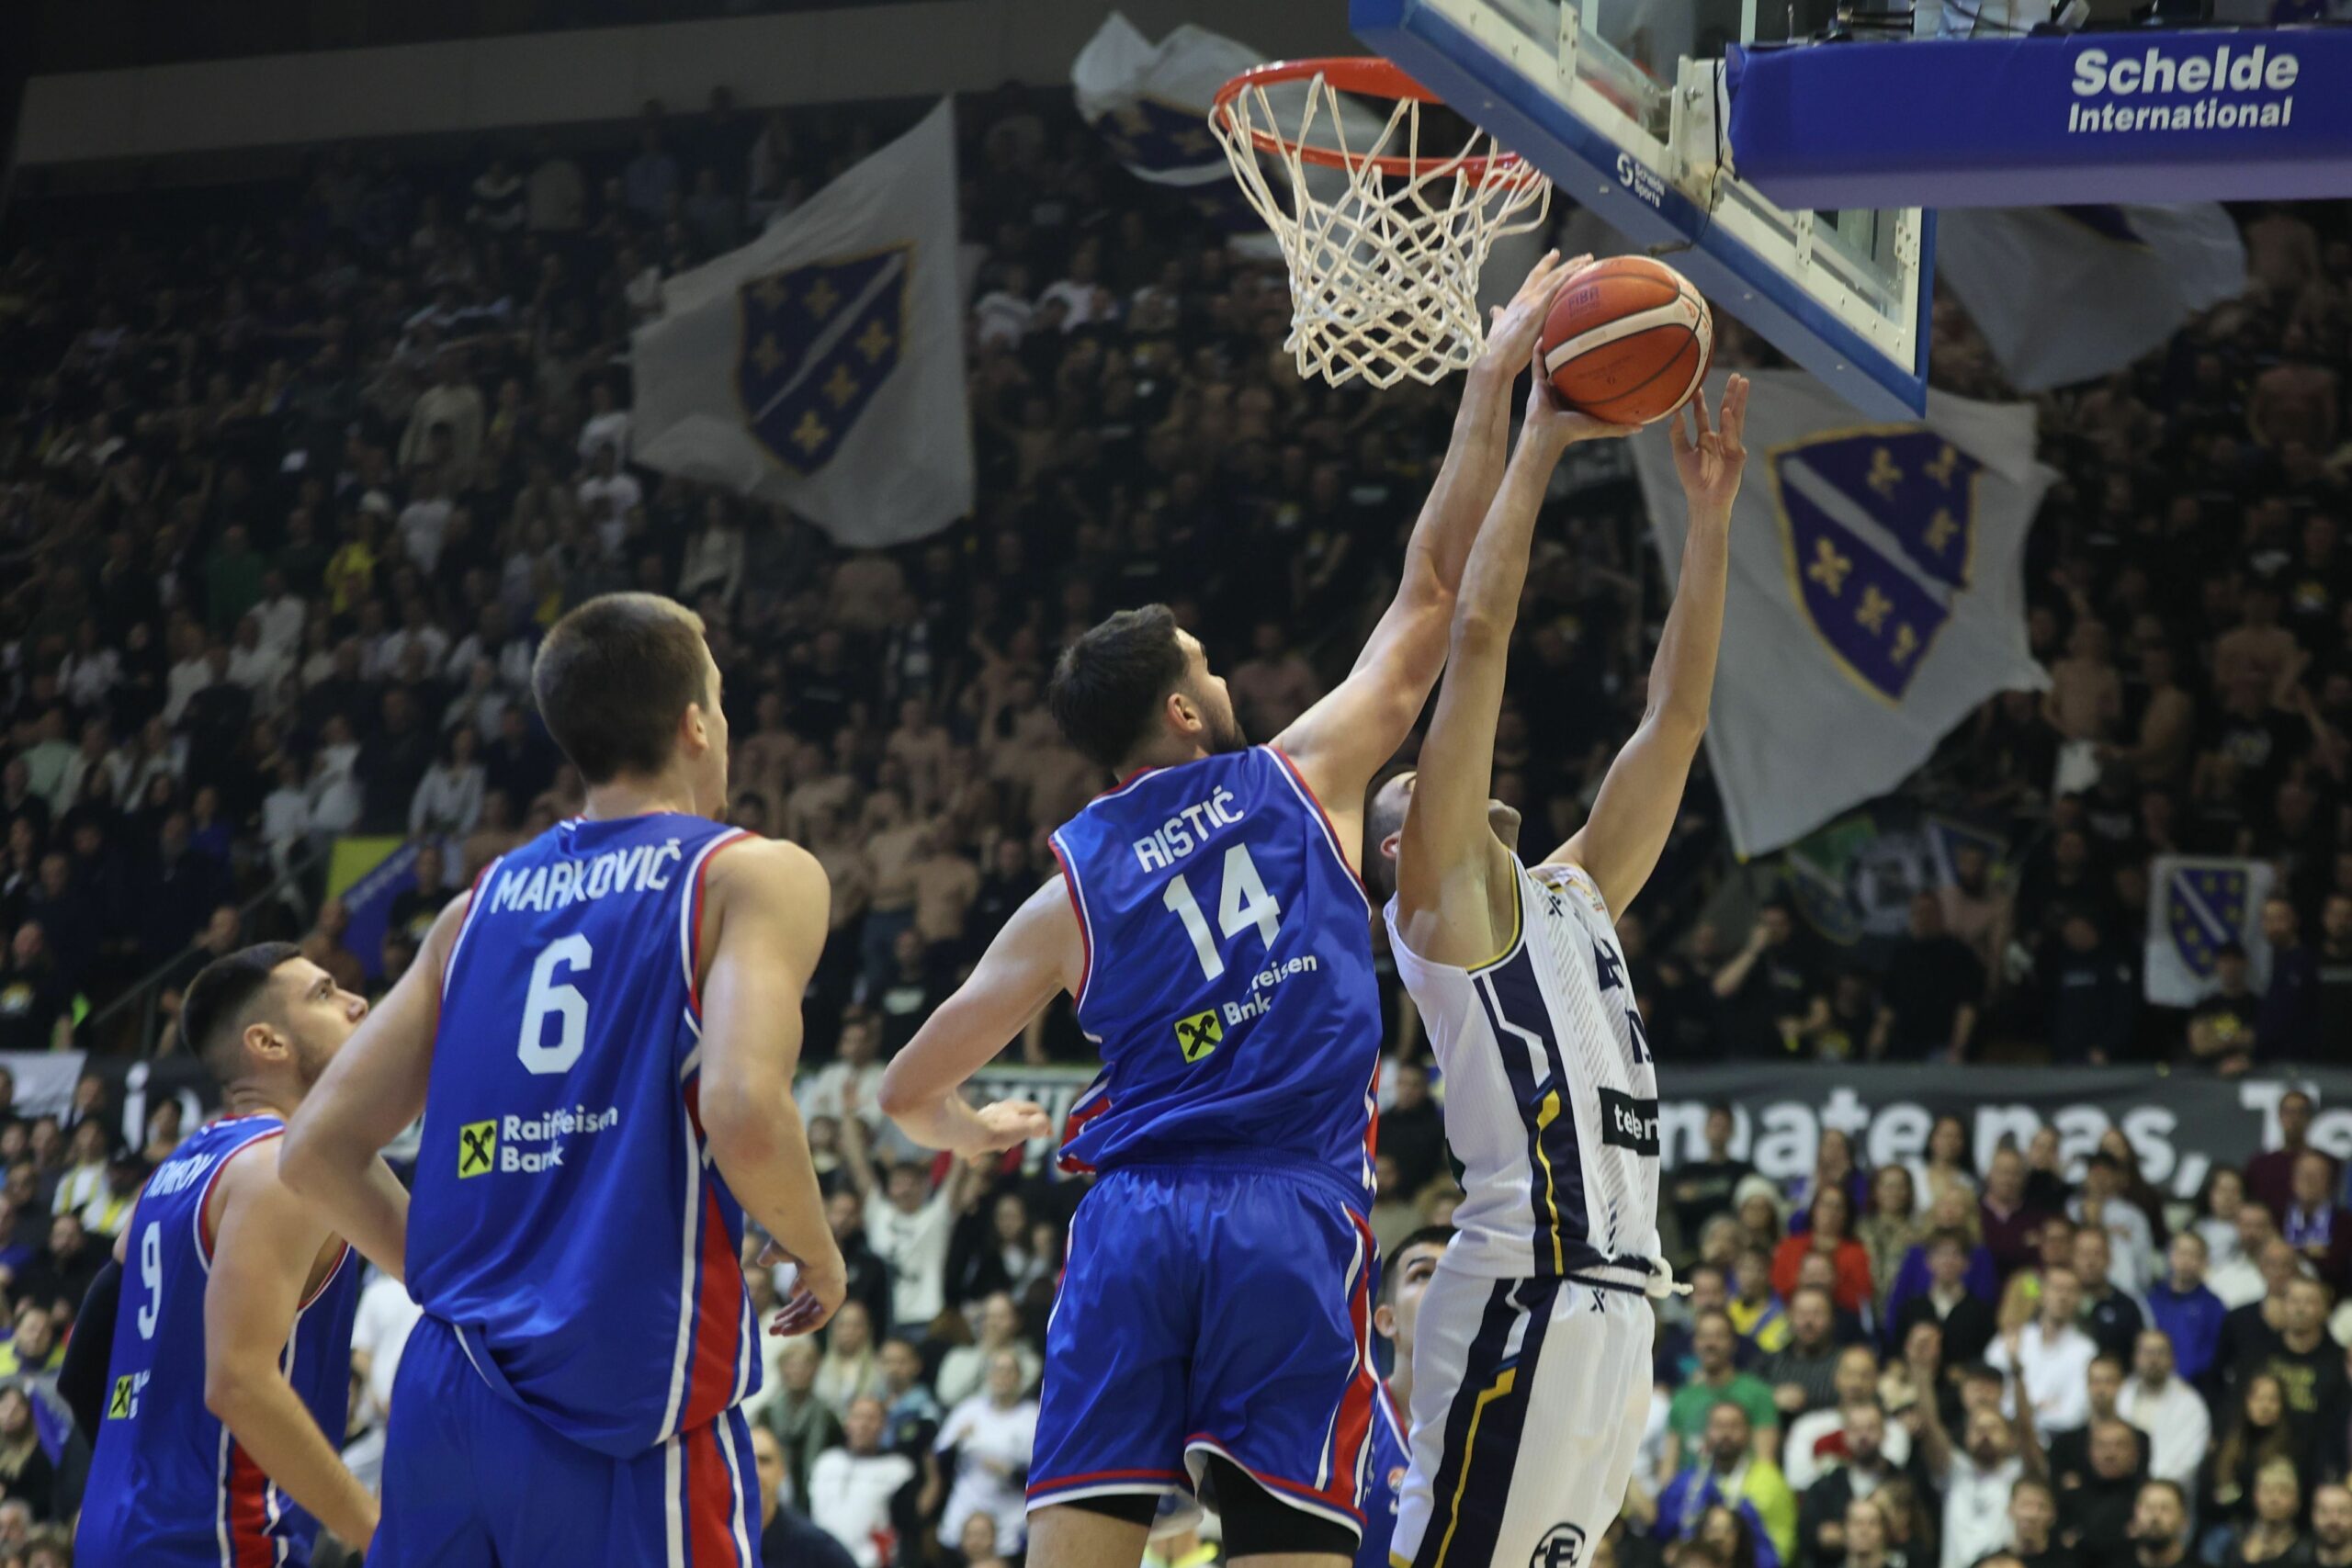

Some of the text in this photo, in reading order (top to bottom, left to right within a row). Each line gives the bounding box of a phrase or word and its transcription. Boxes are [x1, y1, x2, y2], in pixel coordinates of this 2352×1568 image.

[2071, 44, 2299, 96] Schelde
[2068, 96, 2293, 132] International
[1567, 286, 1600, 310] FIBA
[1133, 784, 1244, 874] RISTIĆ
[1162, 842, 1281, 982] 14
[517, 932, 593, 1075] 6
[500, 1139, 564, 1173] Bank
[138, 1221, 163, 1340] 9
